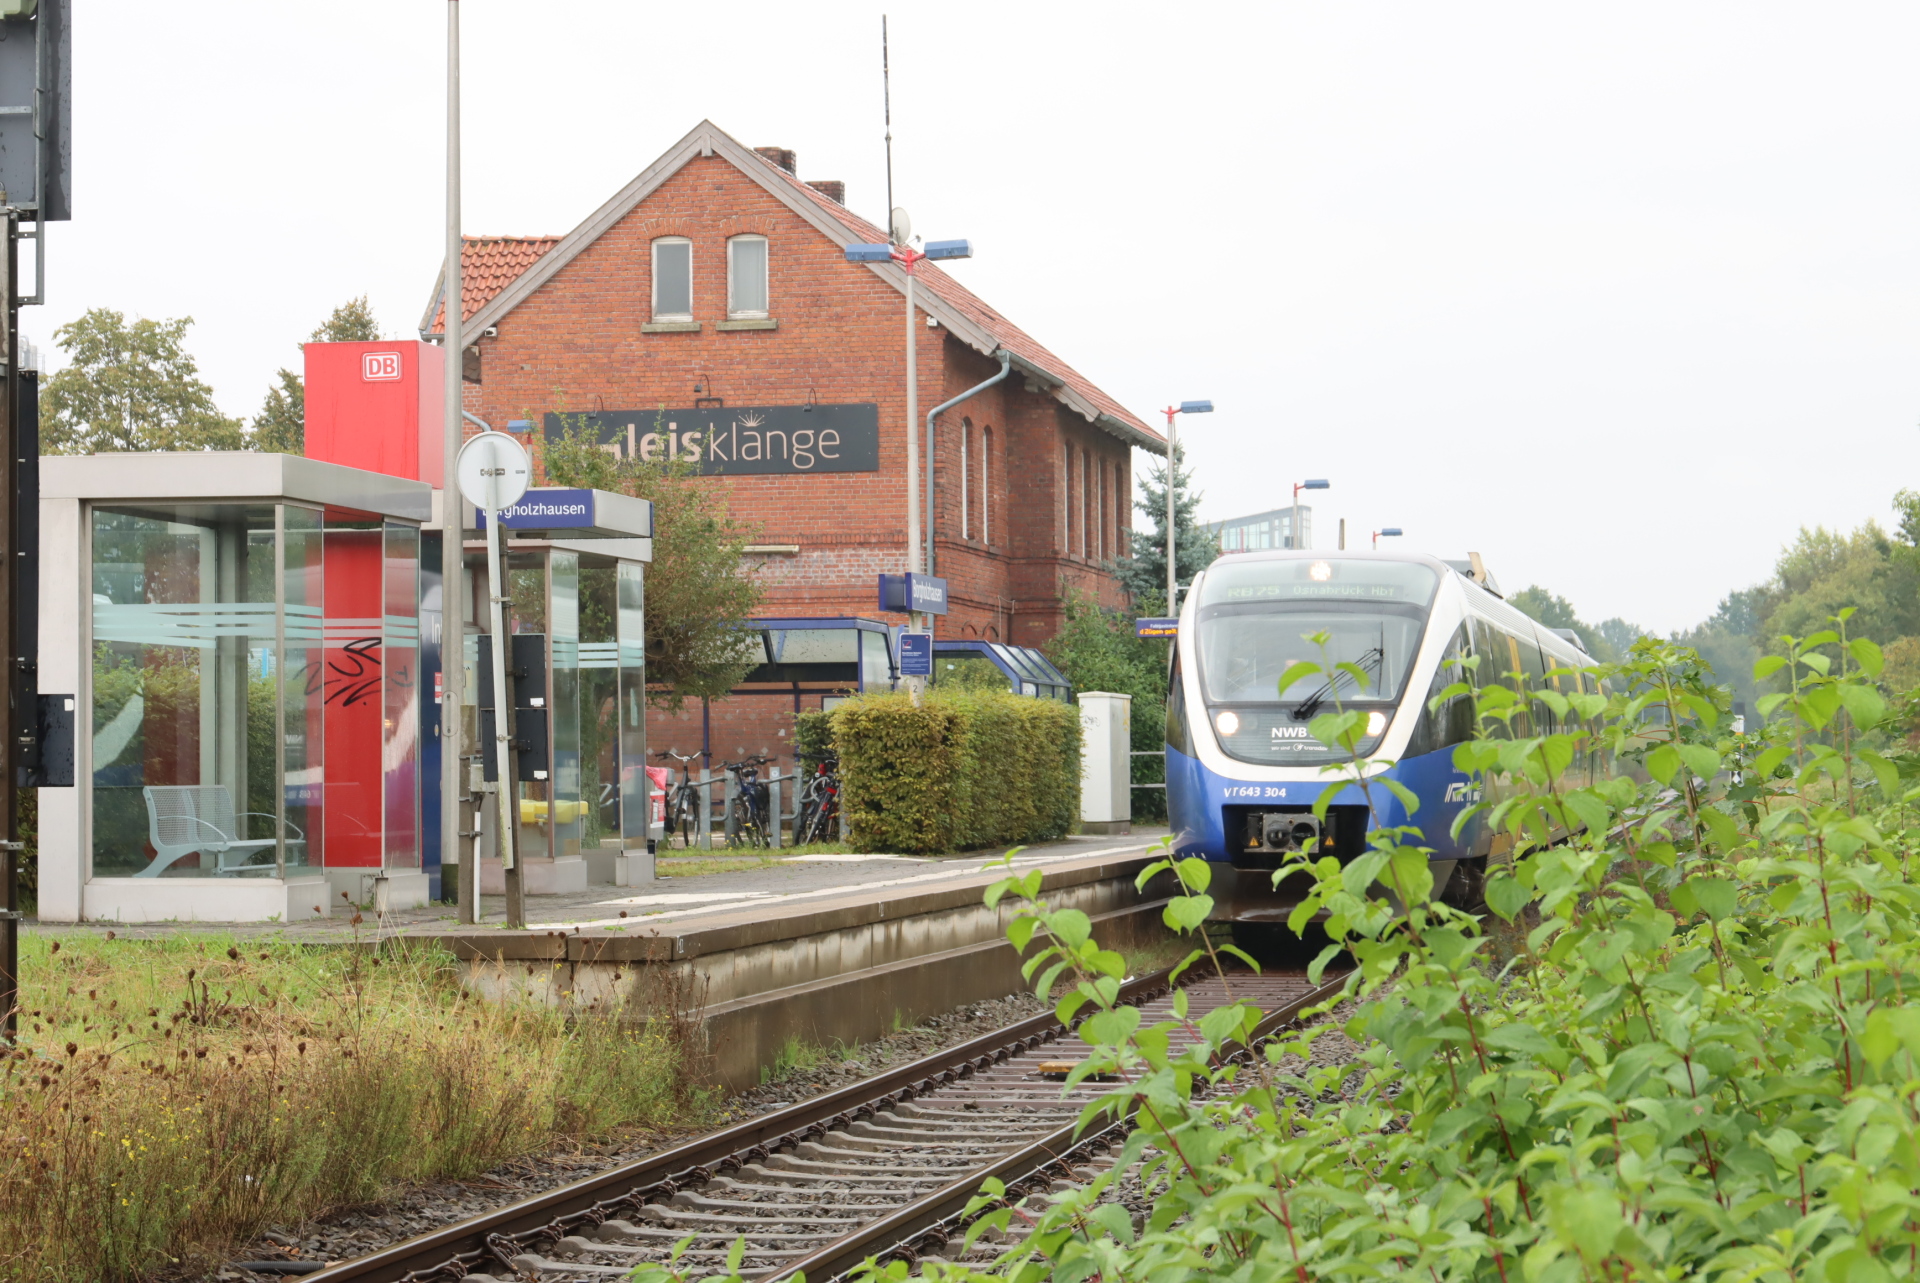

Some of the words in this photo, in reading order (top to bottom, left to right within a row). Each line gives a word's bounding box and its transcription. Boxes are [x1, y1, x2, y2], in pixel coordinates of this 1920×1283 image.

[368, 356, 396, 376] DB
[912, 684, 918, 693] 2
[1271, 726, 1308, 738] NWB
[1264, 786, 1287, 798] 304
